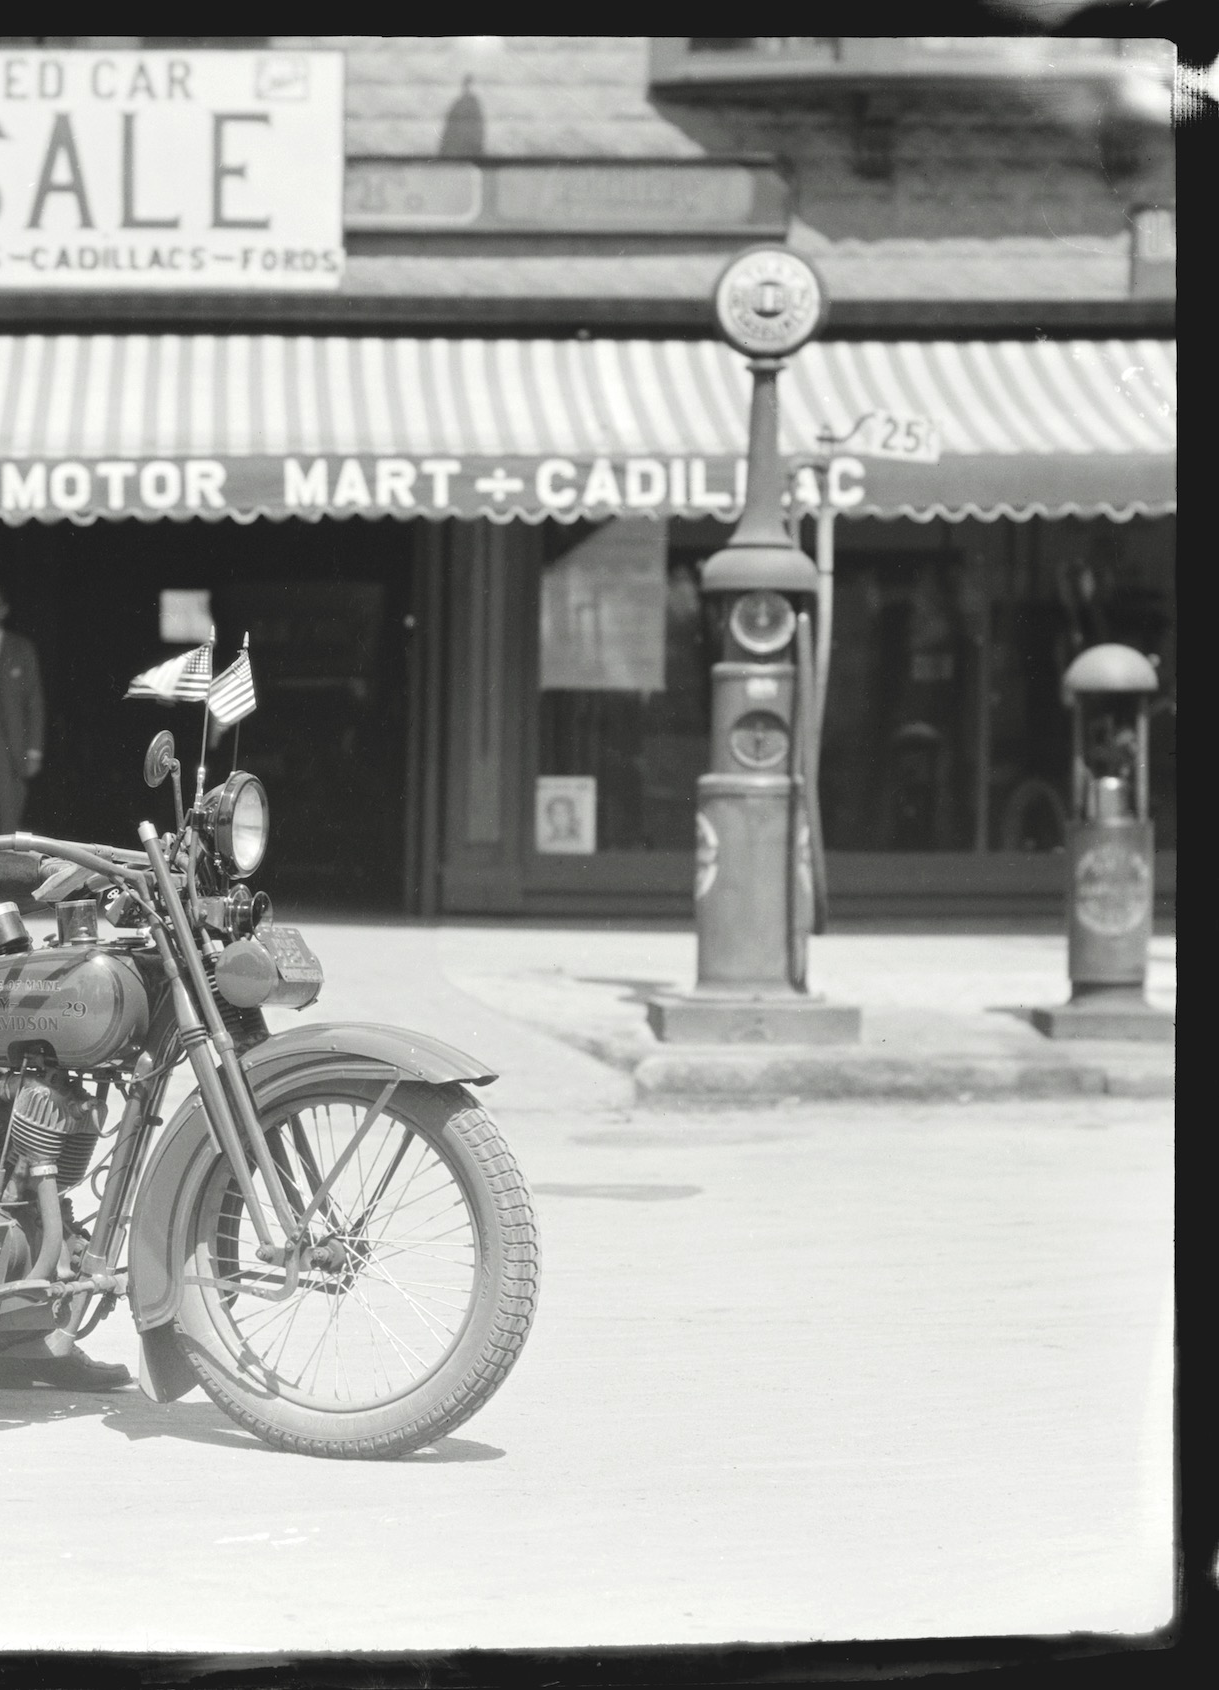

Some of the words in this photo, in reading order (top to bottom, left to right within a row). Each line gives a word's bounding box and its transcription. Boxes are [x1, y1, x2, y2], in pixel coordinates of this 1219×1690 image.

[90, 58, 194, 101] CAR
[0, 460, 228, 511] MOTOR
[283, 458, 463, 511] MART
[8, 980, 22, 991] OF
[26, 980, 62, 992] MAINE
[62, 1001, 88, 1018] 29
